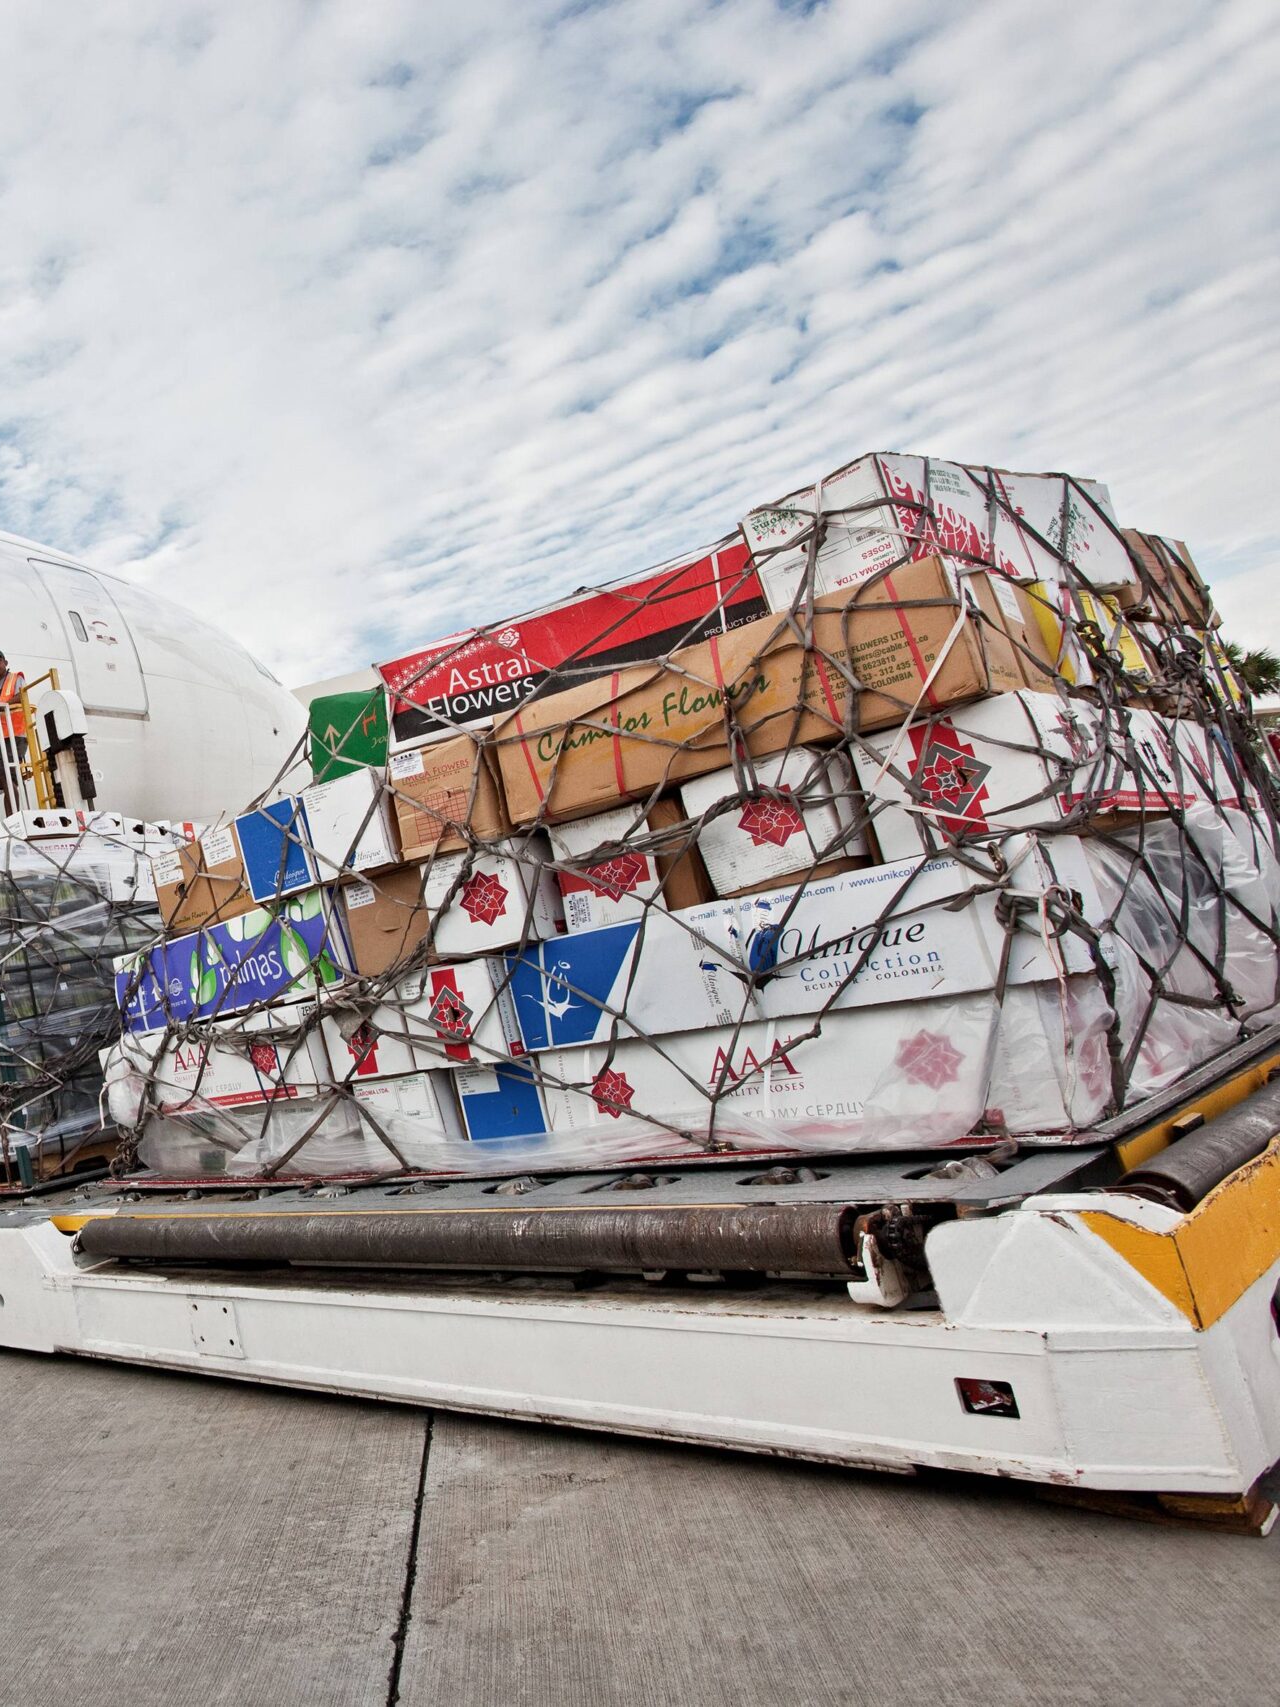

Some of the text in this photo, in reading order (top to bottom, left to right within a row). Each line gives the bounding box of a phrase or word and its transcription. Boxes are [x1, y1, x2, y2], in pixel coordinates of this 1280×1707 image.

[861, 541, 892, 560] ROSES
[872, 549, 896, 562] FLOWERS
[835, 556, 897, 586] JAROMA LTDA.
[703, 619, 745, 637] PROUCT
[745, 613, 758, 624] OF
[850, 635, 889, 653] FLOWERS
[449, 648, 531, 694] Astral
[862, 654, 897, 670] 8623818
[879, 667, 894, 677] 312
[895, 662, 911, 673] 435
[924, 653, 936, 664] 09
[870, 670, 914, 691] COLOMBIA
[422, 676, 538, 722] Flowers
[661, 673, 771, 727] Flowers
[432, 758, 470, 777] FLOWERS
[689, 908, 718, 922] e-mail:
[781, 922, 925, 961] Unique
[219, 947, 283, 991] palmas
[804, 977, 860, 992] ECUADR
[875, 964, 945, 981] COLOMBIA
